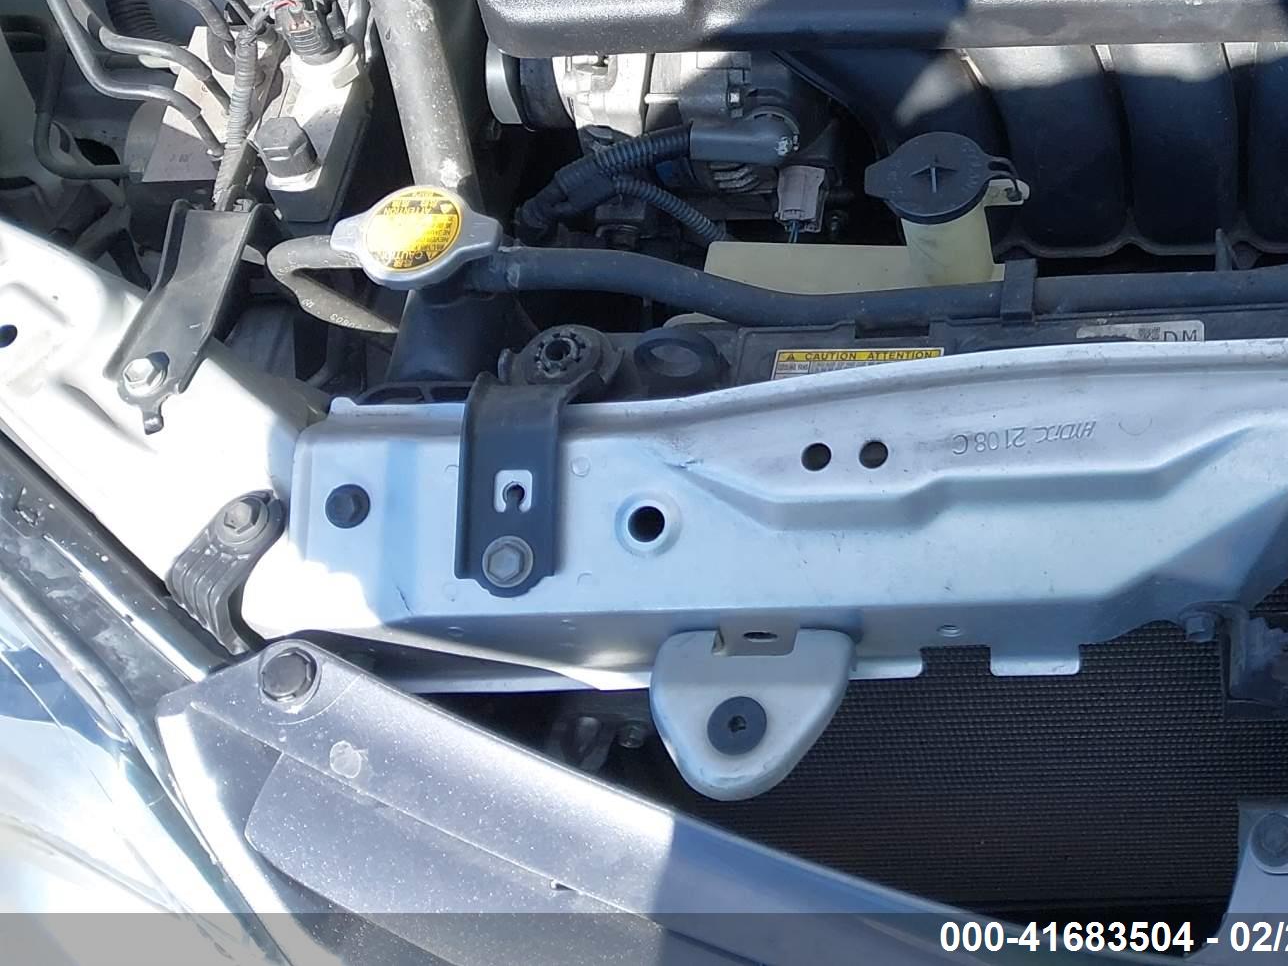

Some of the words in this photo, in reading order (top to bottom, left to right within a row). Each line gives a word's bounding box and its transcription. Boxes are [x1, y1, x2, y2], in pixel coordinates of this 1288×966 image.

[383, 206, 432, 216] ATTENTION
[805, 352, 857, 361] CAUTION
[868, 350, 933, 360] ATTENTION
